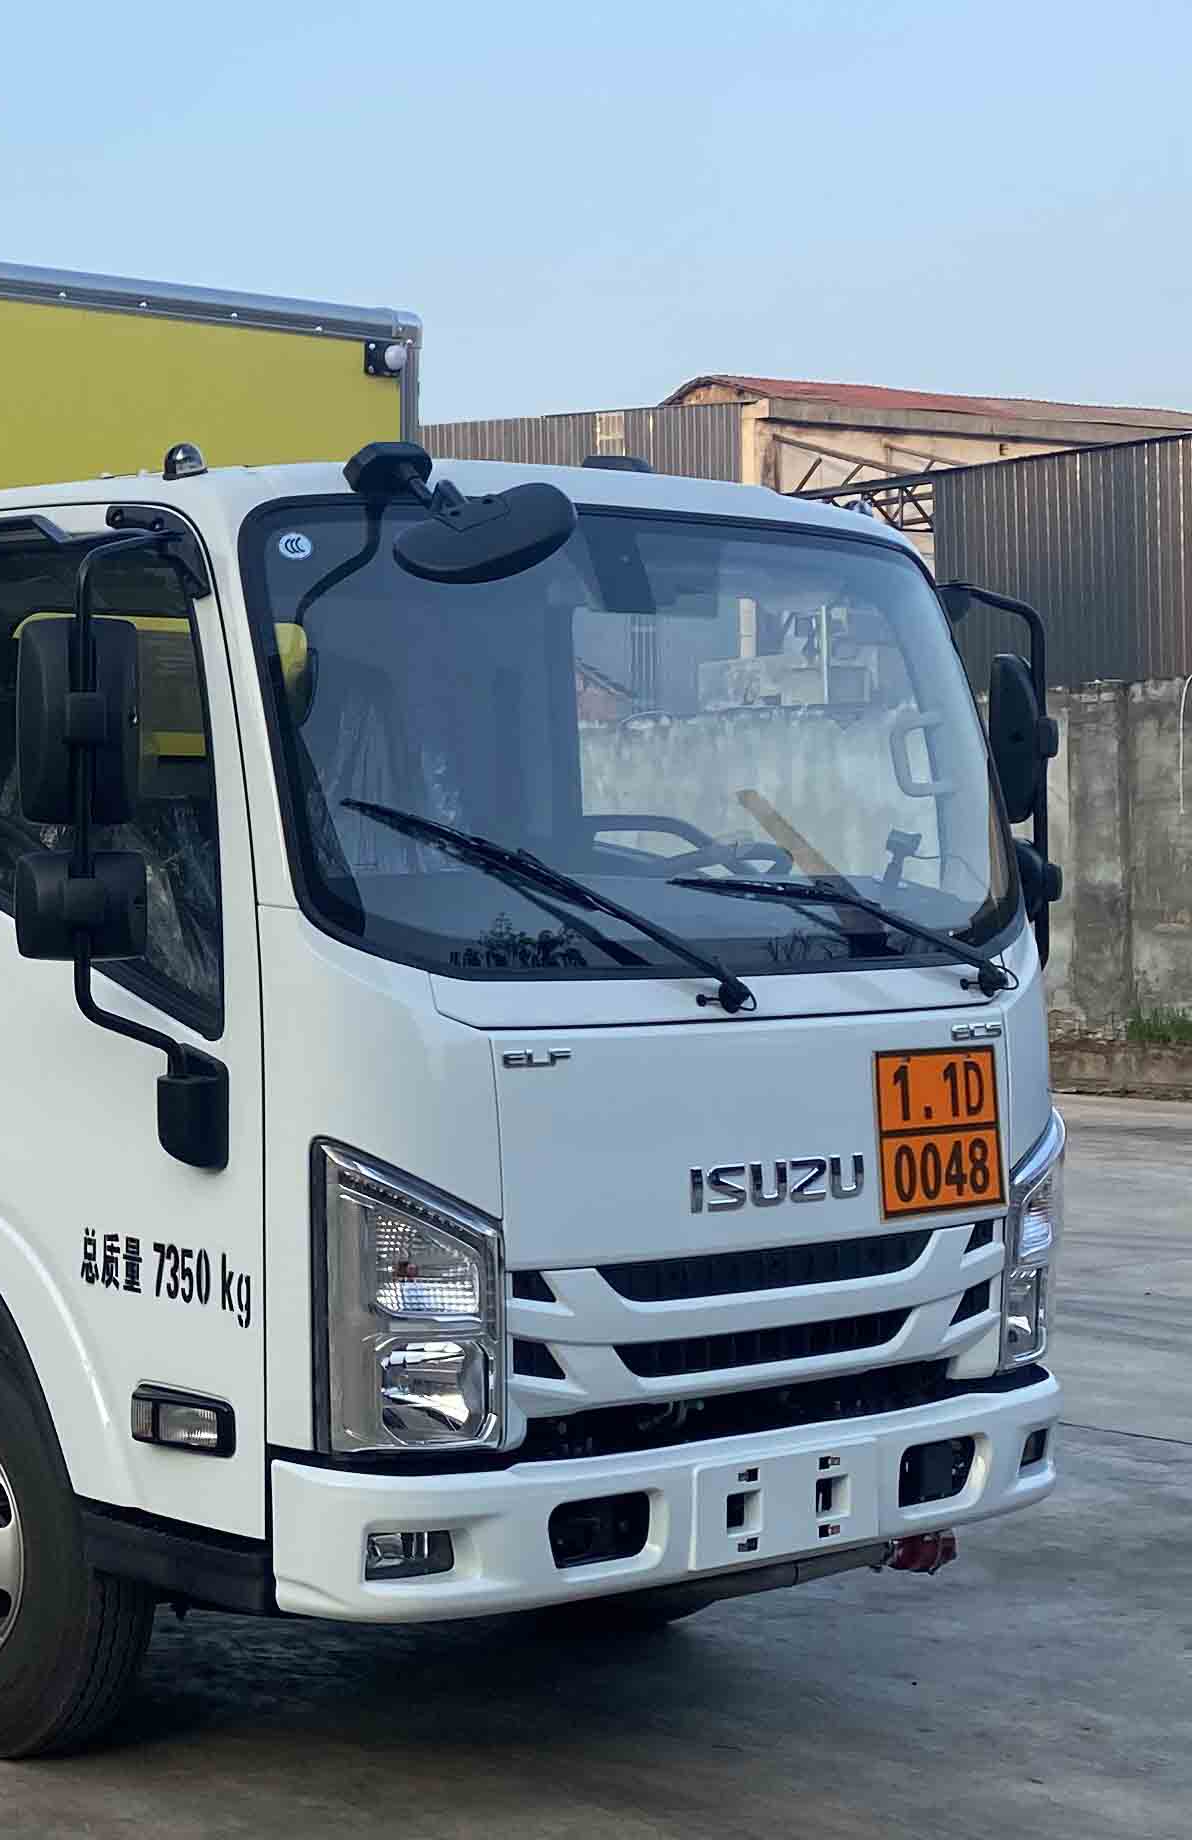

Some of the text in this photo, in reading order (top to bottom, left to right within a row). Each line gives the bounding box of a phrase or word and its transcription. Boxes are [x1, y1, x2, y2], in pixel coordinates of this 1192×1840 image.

[893, 1060, 984, 1121] 1.1D
[690, 1152, 865, 1214] ISUZU
[894, 1138, 990, 1203] 0048
[80, 1226, 251, 1329] 总质量 7350 kg
